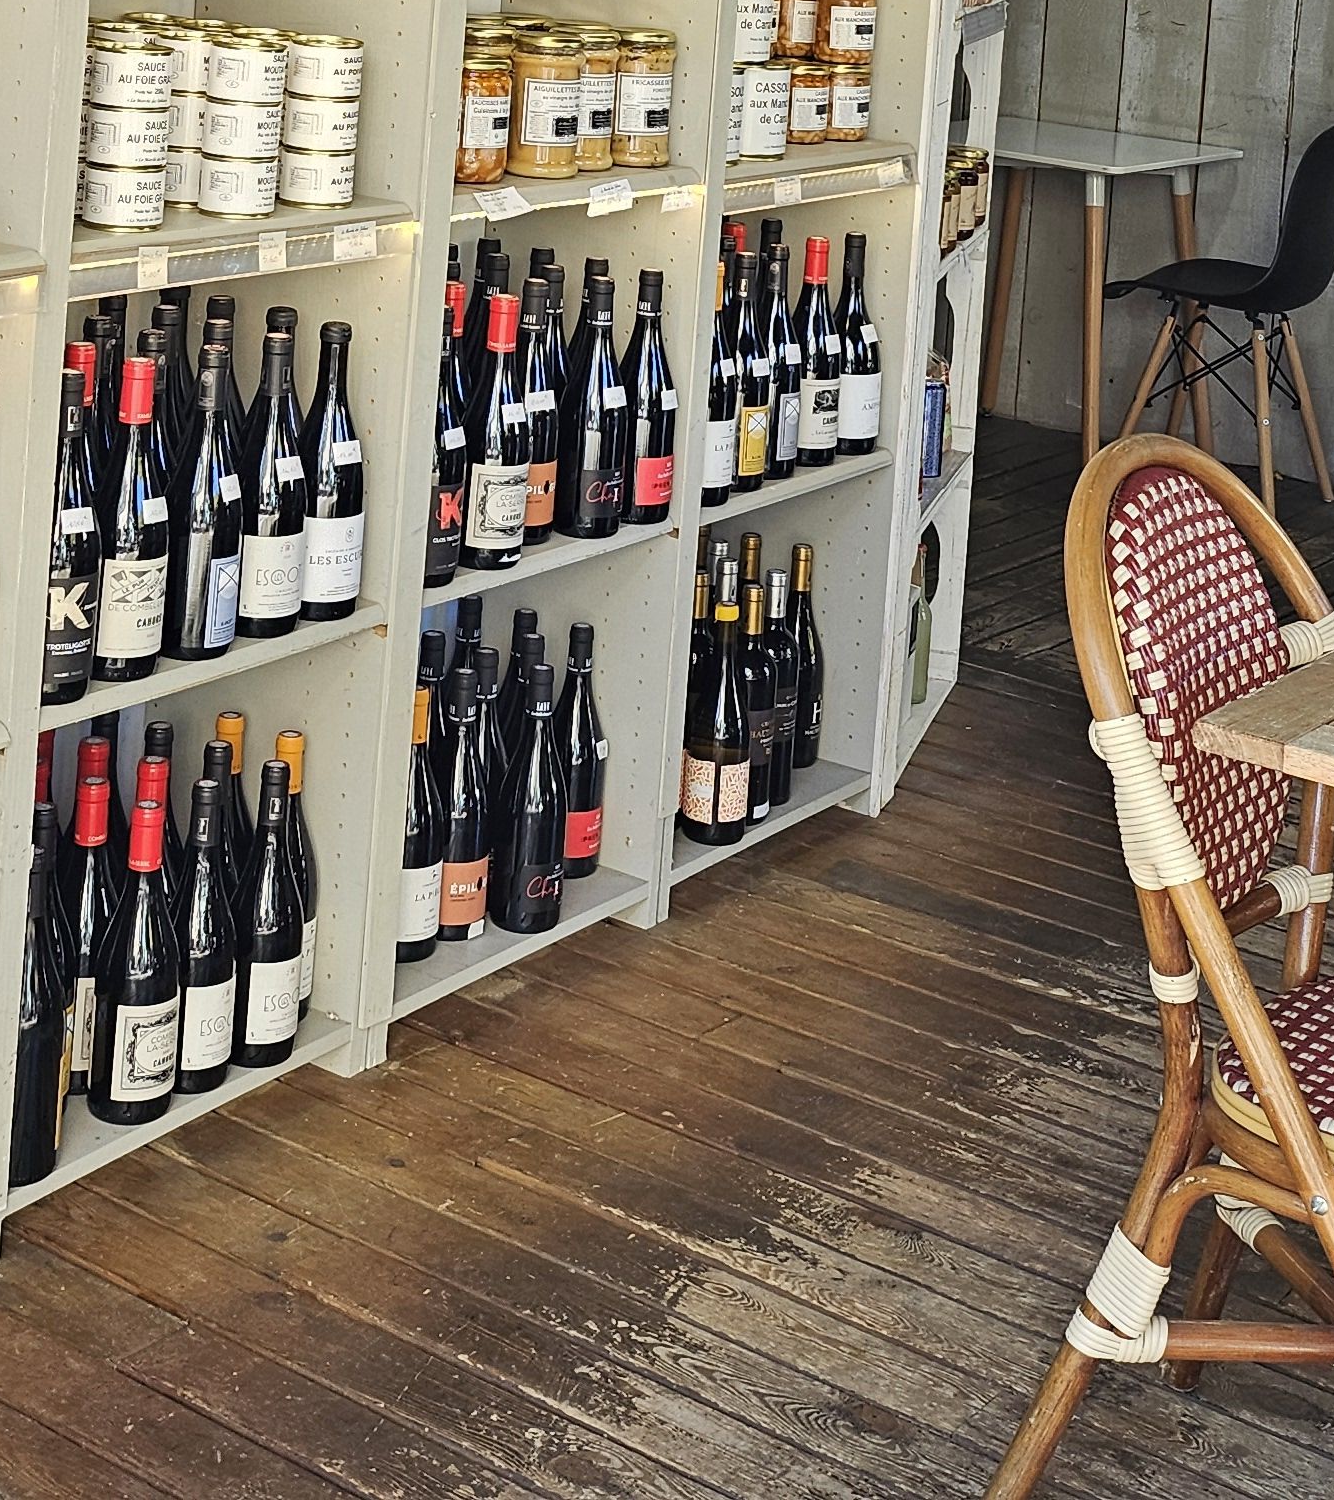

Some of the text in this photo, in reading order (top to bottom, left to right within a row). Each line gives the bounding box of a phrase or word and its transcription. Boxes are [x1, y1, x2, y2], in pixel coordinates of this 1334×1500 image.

[137, 61, 167, 73] SAUCE
[333, 67, 346, 76] AU
[118, 73, 156, 86] AU FOIE
[750, 99, 768, 108] aux
[760, 112, 772, 124] de
[145, 120, 168, 131] SAUCE
[126, 133, 160, 145] AU FOIE
[136, 180, 162, 192] SAUCE
[118, 193, 153, 205] AU FOIE
[309, 554, 333, 566] LES
